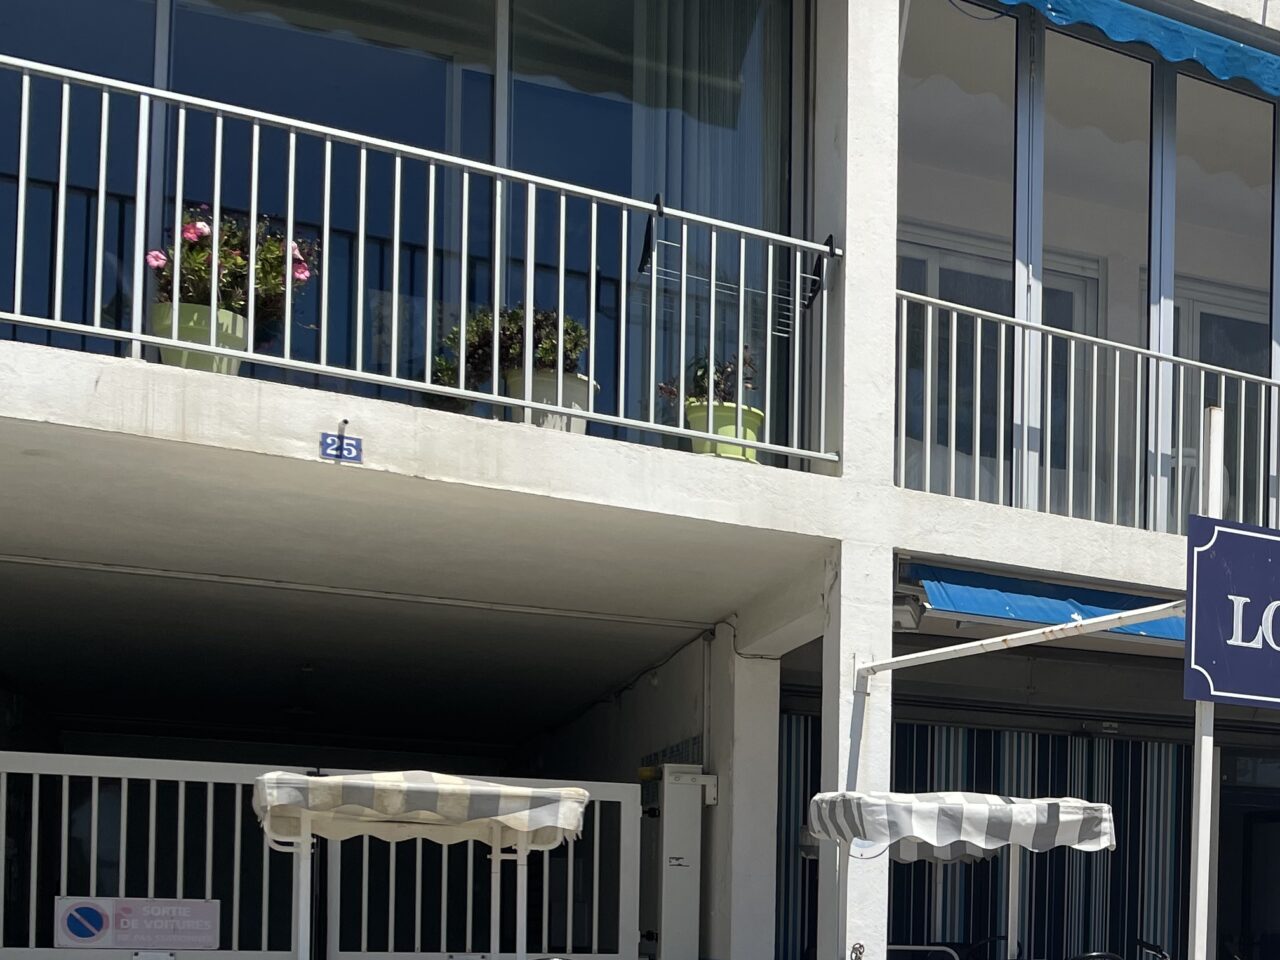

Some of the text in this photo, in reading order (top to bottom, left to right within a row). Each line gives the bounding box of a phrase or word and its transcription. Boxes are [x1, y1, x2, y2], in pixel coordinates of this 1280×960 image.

[326, 436, 357, 457] 25
[142, 906, 191, 917] SORTIE
[120, 918, 212, 930] DE VOITURES
